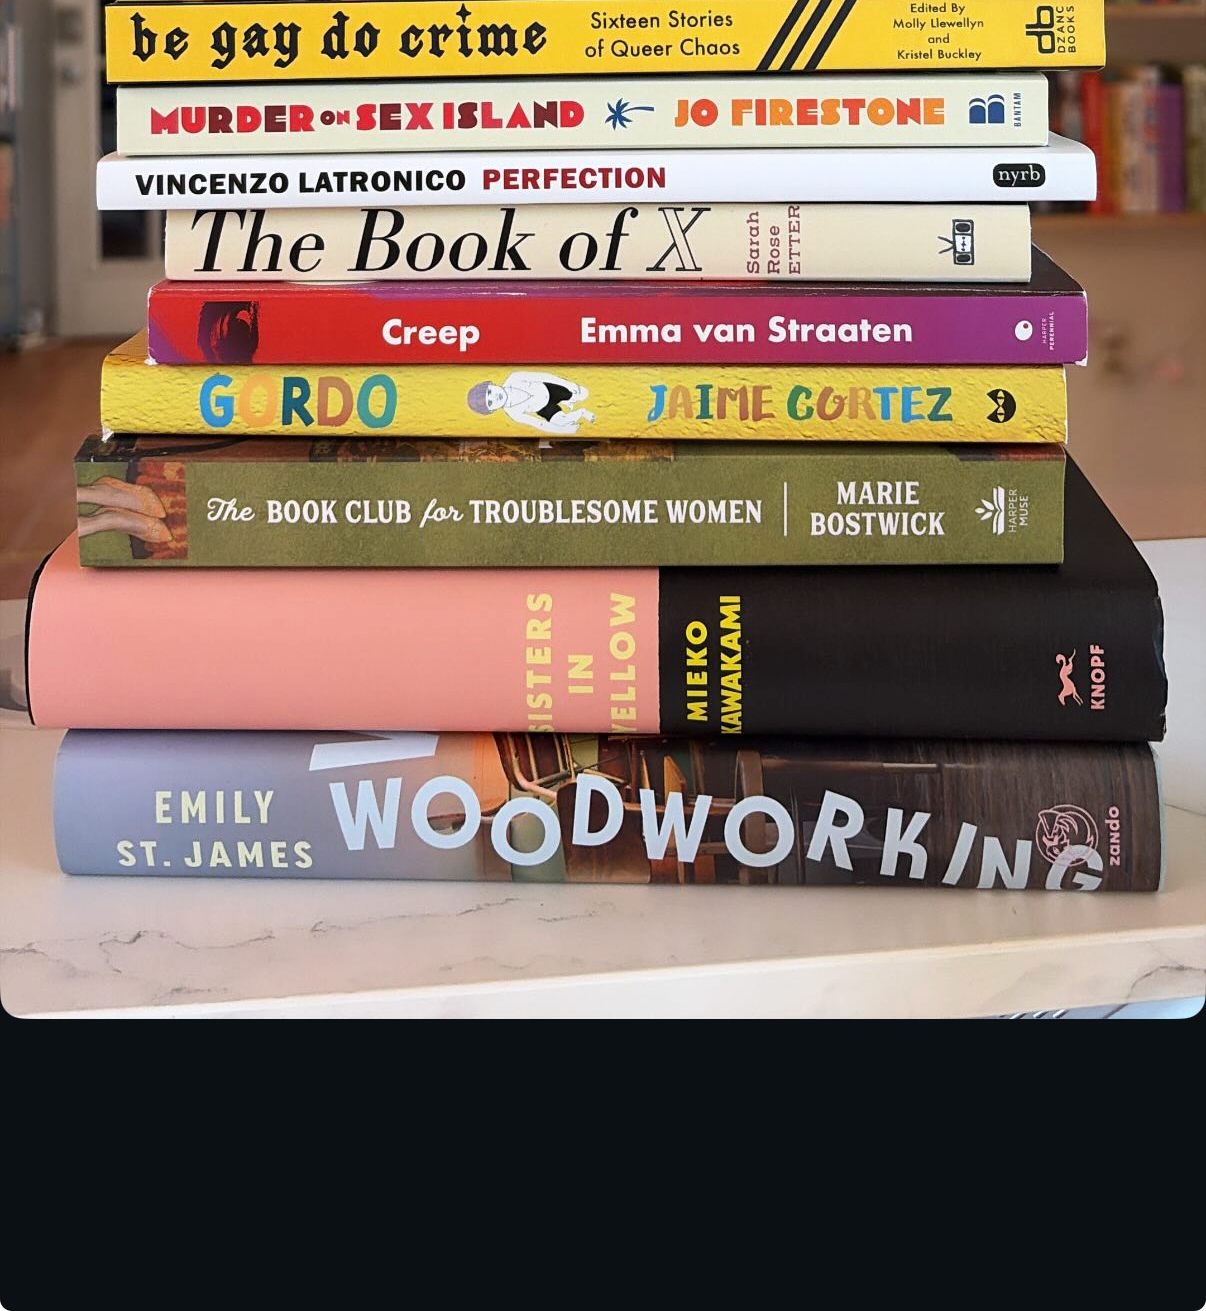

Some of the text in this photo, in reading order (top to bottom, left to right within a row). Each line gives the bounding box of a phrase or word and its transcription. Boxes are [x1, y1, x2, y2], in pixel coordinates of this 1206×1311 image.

[591, 10, 733, 29] Sixteen Stories
[893, 17, 984, 31] Molly Llewellyn
[910, 2, 966, 15] Edited By
[131, 3, 548, 71] be gay do crime
[927, 33, 950, 44] and
[1055, 6, 1066, 53] DZANC
[1066, 5, 1076, 53] BOOKS
[585, 37, 740, 58] of Queer Chaos
[897, 48, 982, 61] Kristel Buckley
[150, 100, 585, 136] MURDER ON SEX ISLAND
[674, 97, 945, 128] JO FIRESTONE
[1013, 92, 1022, 127] BANTAM
[135, 166, 667, 196] VINCENZO LATRONICO PERFECTION
[998, 164, 1041, 186] nyrb
[190, 206, 711, 273] The Book of X
[746, 211, 760, 274] Sarah
[767, 225, 780, 274] Rose
[788, 205, 800, 274] ETTER
[382, 318, 481, 352] Creep
[581, 316, 913, 344] Emma van Straaten
[199, 373, 398, 429] GORDO
[647, 383, 953, 423] JAIME CORTEZ
[836, 481, 920, 506] MARIE
[1008, 489, 1018, 533] HARPER
[1019, 495, 1029, 526] MUSE
[206, 496, 763, 529] The BOOK CLUB for TROUBLESOME WOMEN
[810, 511, 946, 536] BOSTWICK
[568, 654, 594, 694] IN
[686, 621, 708, 721] MIEKO
[1090, 644, 1106, 709] KNOPF
[155, 789, 274, 825] EMILY
[329, 772, 1103, 891] WOODWORKING
[1105, 806, 1121, 866] zando
[116, 840, 314, 869] ST. JAMES
